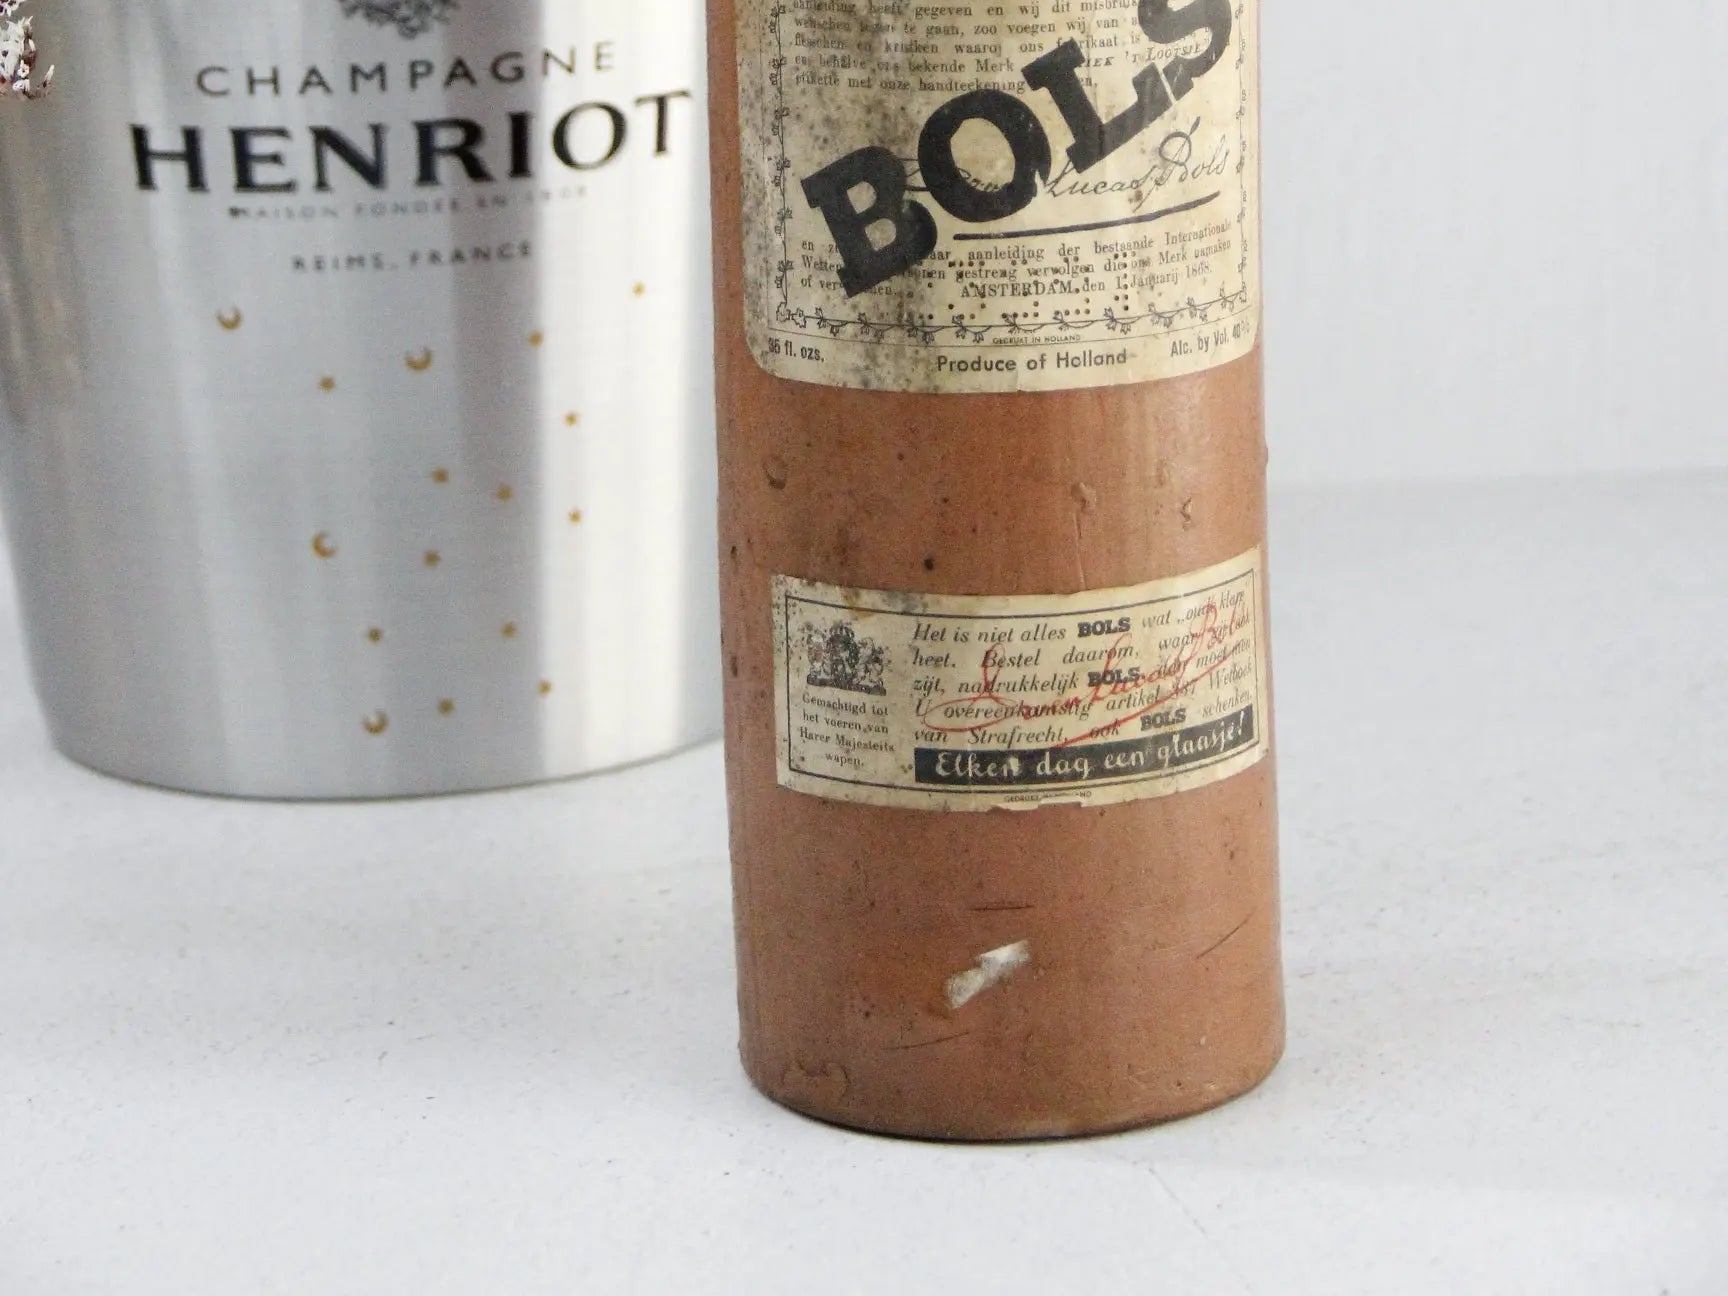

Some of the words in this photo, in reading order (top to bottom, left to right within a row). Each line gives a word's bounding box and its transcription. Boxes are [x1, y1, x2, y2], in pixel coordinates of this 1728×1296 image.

[915, 5, 972, 19] gegeven
[987, 6, 1004, 16] en
[1020, 1, 1040, 19] wij
[1052, 0, 1071, 12] dit
[926, 24, 964, 38] gaan,
[974, 25, 998, 35] zoo
[1007, 21, 1056, 36] voegen
[1066, 16, 1087, 34] wij
[1096, 17, 1119, 28] van
[1020, 41, 1044, 52] ons
[196, 41, 615, 97] CHAMPAGNE
[908, 59, 966, 73] bekende
[976, 58, 1014, 73] Merk
[847, 77, 872, 89] met
[918, 77, 1026, 95] handteekening
[130, 89, 692, 194] HENRIOT
[801, 240, 814, 250] en
[968, 245, 1044, 261] aanleiding
[1058, 243, 1081, 255] der
[1094, 235, 1154, 254] bestaande
[1164, 220, 1232, 246] Internationale
[409, 241, 532, 267] FRANCE
[955, 266, 1018, 283] gestreng
[1027, 260, 1095, 278] vervolgen
[1159, 247, 1188, 265] Merk
[1194, 238, 1232, 259] namaken
[801, 277, 813, 288] of
[1083, 279, 1105, 291] den
[784, 339, 797, 357] fl.
[1031, 336, 1041, 344] IN
[1044, 334, 1081, 343] HOLLAND
[1170, 338, 1193, 357] Alc.
[1197, 335, 1210, 353] by
[1213, 329, 1231, 347] Vol.
[937, 354, 1017, 372] Produce
[1026, 352, 1047, 371] of
[1056, 349, 1127, 369] Holland
[913, 622, 947, 642] Het
[953, 626, 969, 643] is
[977, 626, 1014, 643] niet
[1020, 622, 1067, 642] alles
[1077, 616, 1131, 638] BOLS
[1142, 610, 1171, 629] wat
[912, 648, 956, 669] heet.
[981, 649, 1041, 669] Bestel
[1062, 645, 1140, 665] daarom,
[914, 676, 945, 697] zijt,
[957, 671, 1080, 696] nadrukkelijk
[1106, 685, 1161, 711] artikel
[1209, 662, 1252, 690] Wetboek
[802, 692, 867, 716] Gemachtigd
[872, 704, 889, 716] tot
[803, 708, 819, 723] het
[824, 716, 861, 731] voeren
[867, 723, 889, 734] van
[914, 730, 949, 743] van
[967, 725, 1069, 749] Strafrecht,
[1090, 719, 1121, 739] ook
[1140, 707, 1187, 731] BOLS
[800, 726, 831, 743] Harer
[836, 733, 896, 752] Majesteits
[935, 751, 1020, 779] Elken
[1036, 749, 1092, 781] dag
[1104, 749, 1147, 769] een
[1157, 710, 1245, 769] glaasje!
[825, 753, 865, 768] wapen.
